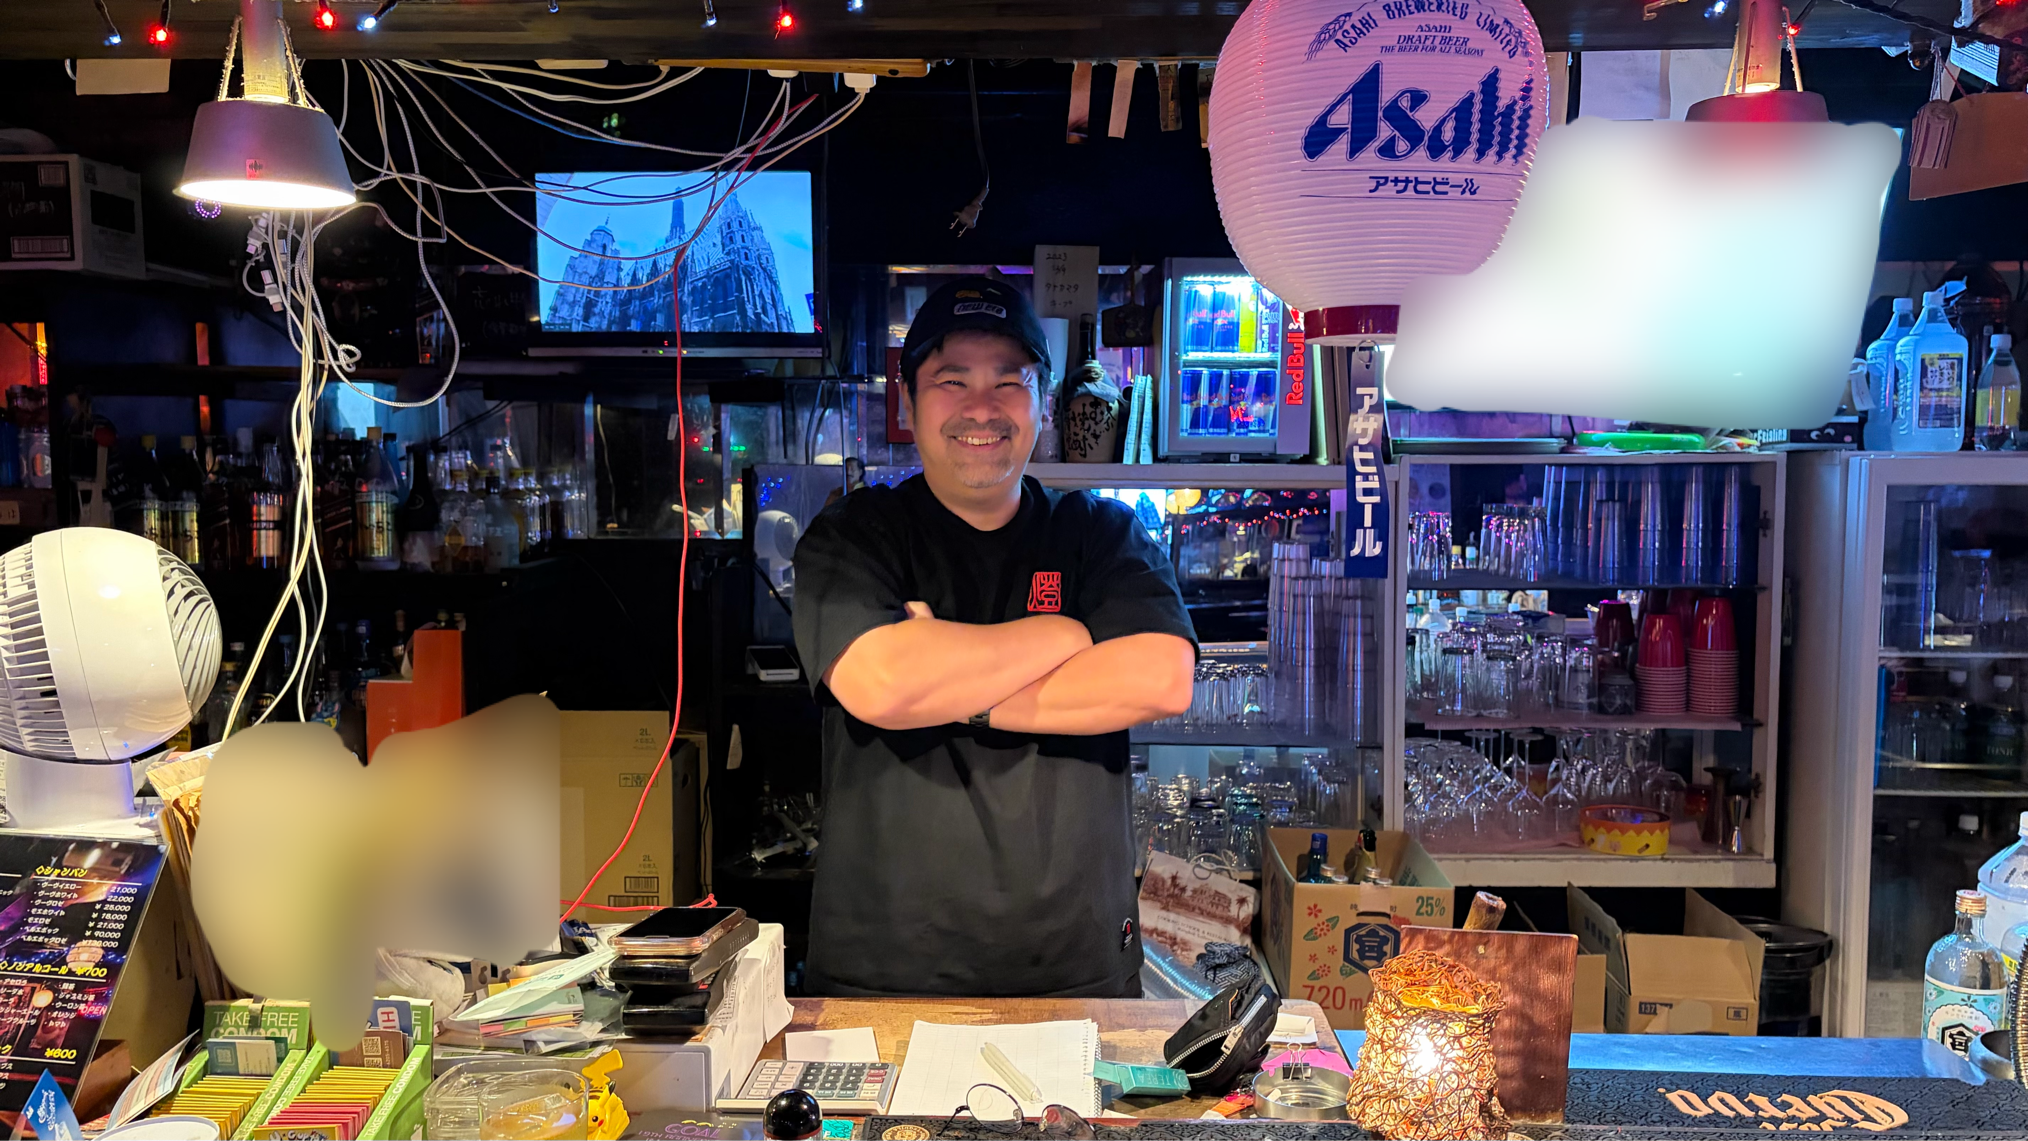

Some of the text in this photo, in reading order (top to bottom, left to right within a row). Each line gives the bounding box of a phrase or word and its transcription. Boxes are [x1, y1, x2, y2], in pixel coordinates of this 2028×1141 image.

[1334, 12, 1379, 52] ASAHI
[1415, 24, 1452, 33] ASAHI
[1380, 45, 1395, 53] THE
[1397, 45, 1419, 53] BEER
[1421, 45, 1436, 53] FOR
[1438, 46, 1453, 54] ALL
[1396, 35, 1470, 47] DRAFT BEER
[1301, 60, 1533, 166] Asahi
[1368, 175, 1480, 197] アサヒビール
[1286, 332, 1305, 405] Red Bull
[1350, 387, 1382, 558] アサヒビール
[1415, 896, 1446, 917] 25%
[7, 962, 107, 977] ノンアルコール ¥700
[1302, 984, 1346, 1010] 720
[81, 1005, 108, 1015] OPEN
[213, 1011, 299, 1027] TAKE FREE
[44, 1048, 77, 1060] ¥600
[265, 1062, 296, 1100] CONDOM
[364, 1113, 383, 1137] TAKE
[380, 1093, 396, 1115] FREE
[392, 1057, 422, 1093] CONDOM
[665, 1123, 721, 1138] GOAL
